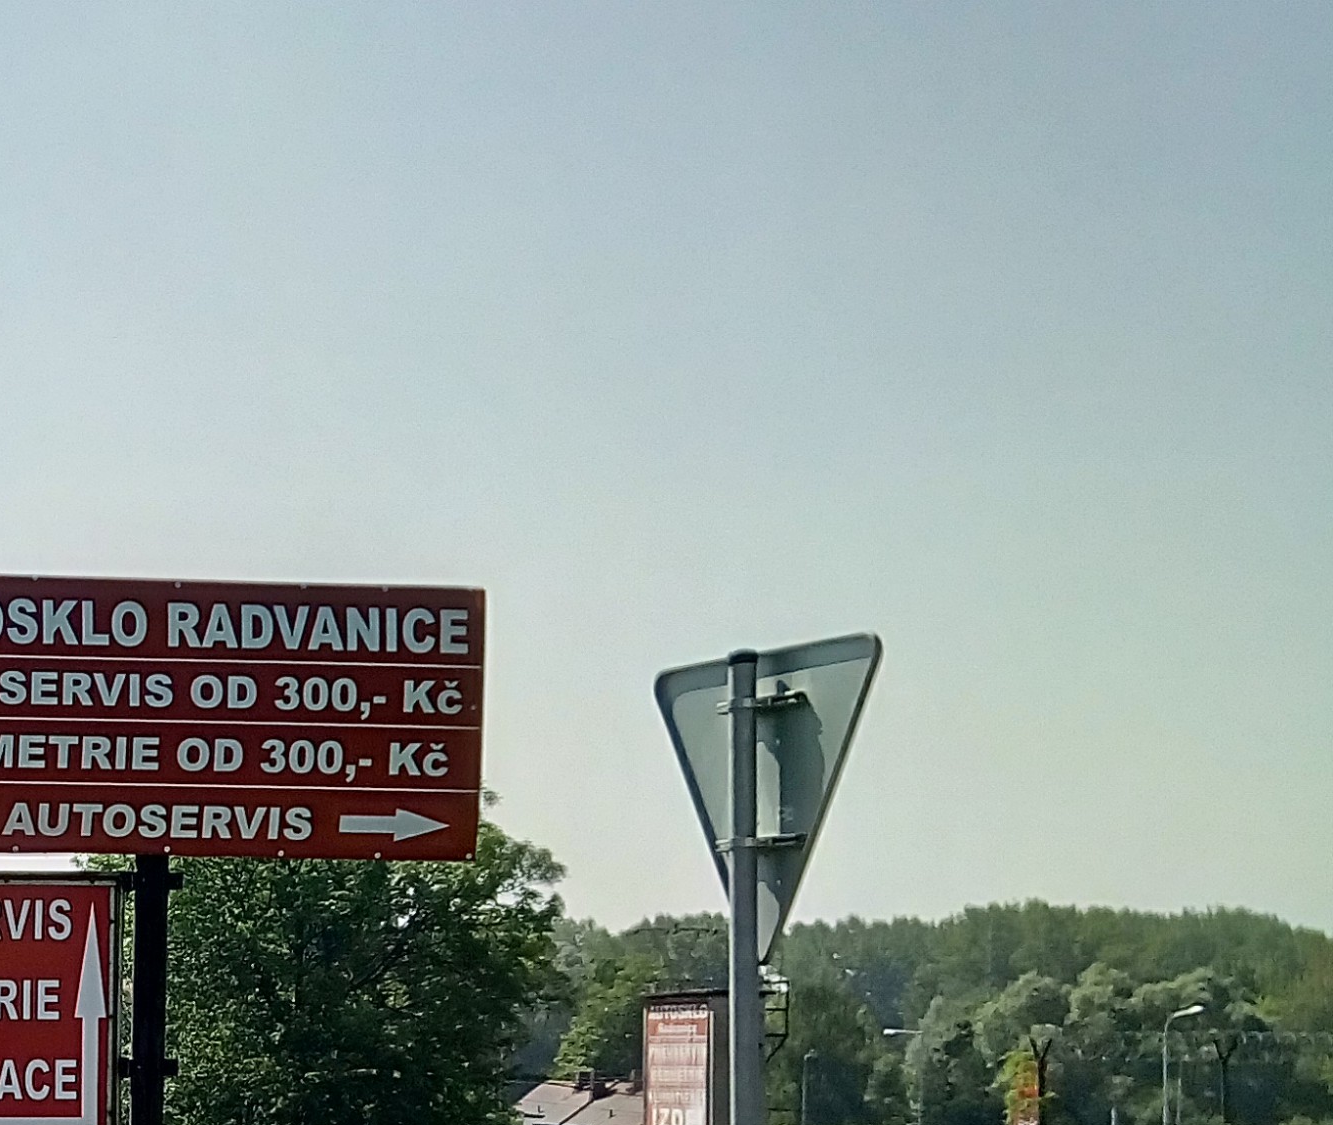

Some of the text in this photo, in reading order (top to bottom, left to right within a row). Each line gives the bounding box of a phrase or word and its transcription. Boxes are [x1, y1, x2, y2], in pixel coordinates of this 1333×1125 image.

[166, 602, 469, 655] RADVANICE
[190, 675, 258, 709] OD
[274, 676, 387, 721] 300,-
[403, 680, 463, 714] Kč
[177, 737, 244, 772] OD
[260, 739, 373, 783] 300,-
[388, 743, 449, 776] Kč
[1, 802, 313, 841] AUTOSERVIS
